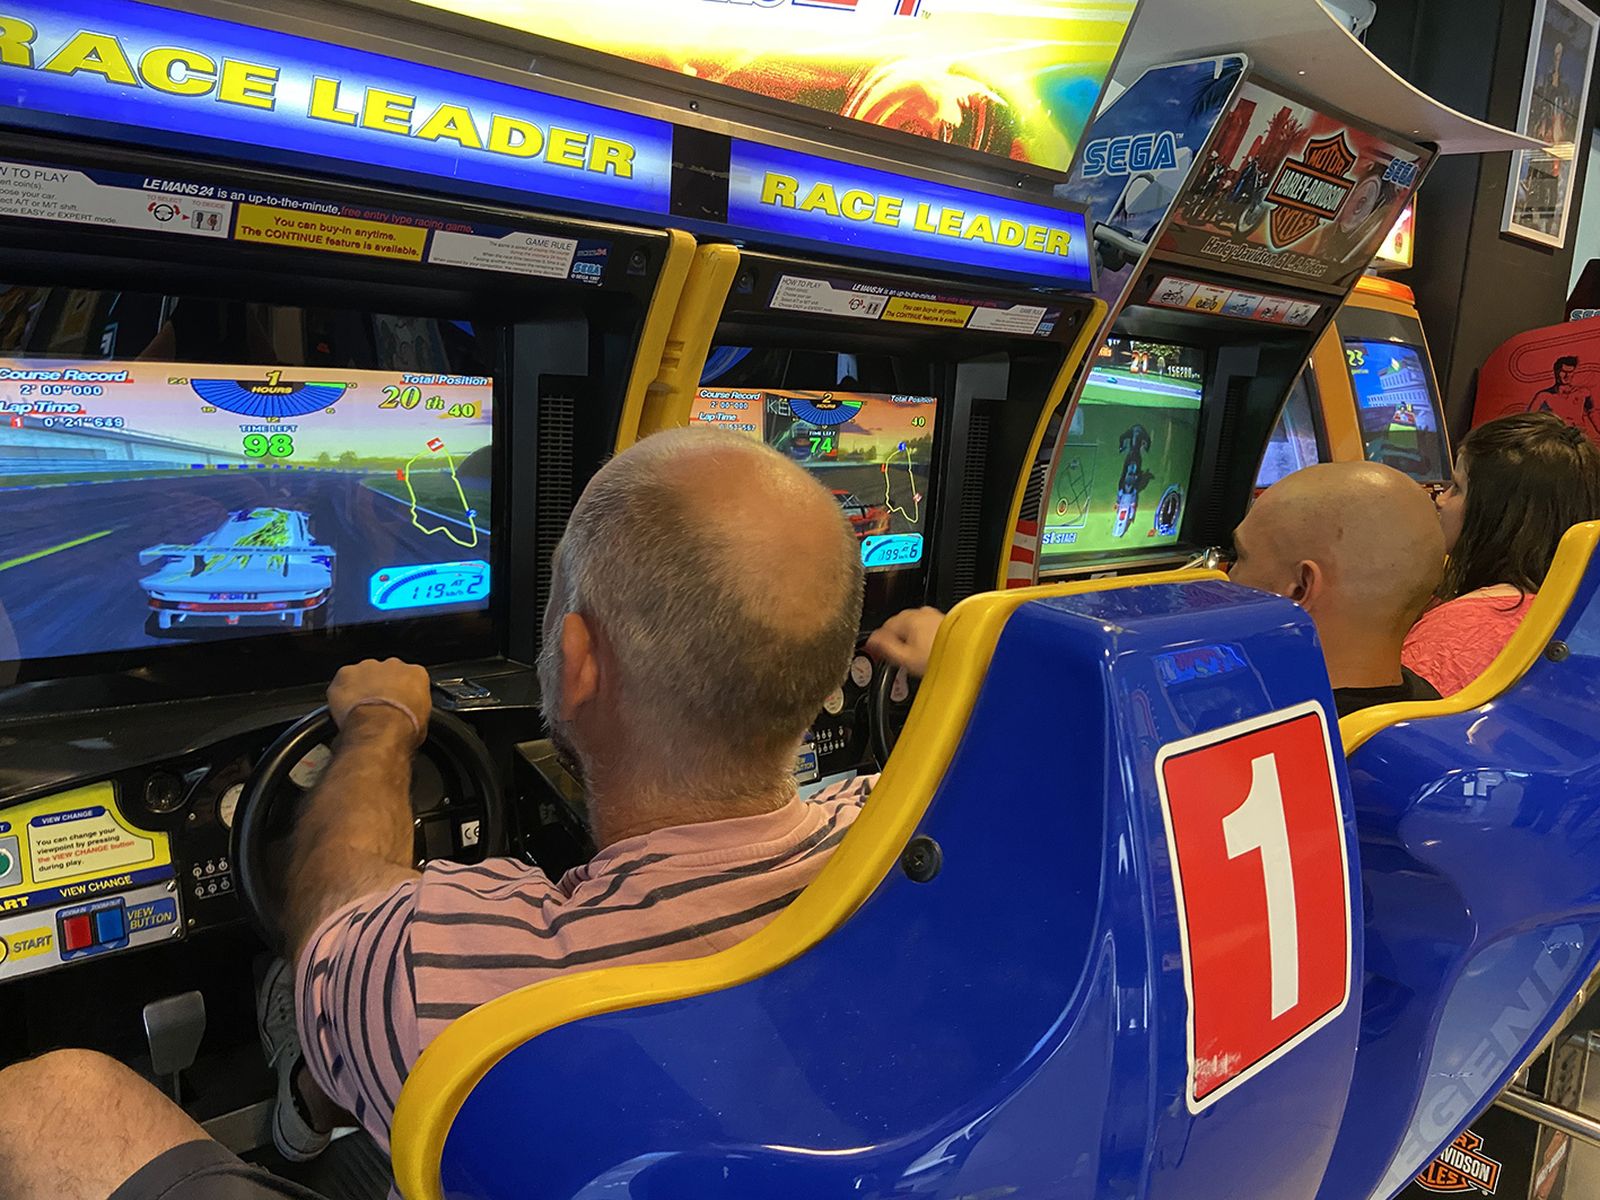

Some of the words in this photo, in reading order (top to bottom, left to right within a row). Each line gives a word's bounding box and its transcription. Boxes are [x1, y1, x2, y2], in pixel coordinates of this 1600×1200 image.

[0, 15, 281, 111] RACE
[307, 75, 636, 179] LEADER
[1081, 130, 1179, 179] SEGA
[1307, 145, 1344, 176] MOTOR
[12, 167, 31, 180] TO
[34, 170, 68, 183] PLAY
[1382, 157, 1420, 189] SEGA
[22, 190, 40, 199] your
[142, 176, 161, 190] LE
[161, 181, 199, 195] MANS
[198, 186, 215, 197] 24
[217, 188, 228, 199] is
[230, 192, 246, 202] an
[1273, 167, 1349, 214] HARLEY-DAVIDSON
[20, 207, 45, 216] EASY
[58, 211, 93, 221] EXPERT
[760, 171, 905, 228] RACE
[913, 202, 1073, 257] LEADER
[273, 216, 295, 228] You
[298, 221, 317, 230] can
[320, 222, 352, 236] buy-in
[240, 225, 262, 237] The
[264, 229, 324, 244] CONTINUE
[325, 236, 361, 249] feature
[363, 241, 372, 251] is
[525, 237, 550, 249] GAME
[551, 240, 573, 251] RULE
[1130, 349, 1150, 374] 21
[1346, 349, 1365, 367] 23
[0, 368, 62, 381] Course
[64, 369, 129, 382] Record
[265, 370, 282, 386] 1
[402, 373, 435, 385] Total
[437, 374, 489, 386] Position
[251, 386, 293, 395] HOURS
[699, 389, 731, 399] Course
[730, 391, 762, 400] Record
[822, 392, 834, 404] 2
[0, 401, 33, 415] Lap
[34, 401, 82, 414] Time
[378, 385, 422, 410] 20
[425, 395, 445, 410] th
[448, 403, 476, 418] 40
[907, 396, 935, 404] Position
[699, 412, 715, 422] Lap
[715, 412, 737, 421] Time
[911, 416, 926, 428] 40
[239, 424, 270, 433] TIME
[269, 425, 298, 433] LEFT
[243, 433, 294, 459] 98
[809, 437, 833, 454] 74
[909, 543, 919, 559] 6
[412, 583, 446, 600] 119
[466, 574, 484, 595] 2
[450, 579, 465, 587] AT
[41, 815, 61, 825] VIEW
[61, 809, 93, 821] CHANGE
[36, 839, 52, 847] You
[53, 836, 68, 844] can
[69, 830, 98, 842] change
[99, 827, 116, 837] your
[36, 843, 75, 856] viewpoint
[75, 841, 86, 849] by
[87, 835, 121, 847] pressing
[37, 856, 51, 864] the
[52, 851, 73, 862] VIEW
[74, 844, 109, 858] CHANGE
[110, 839, 135, 850] button
[38, 861, 65, 873] during
[60, 884, 87, 898] VIEW
[88, 875, 134, 892] CHANGE
[1221, 753, 1299, 1022] 1
[127, 906, 155, 921] VIEW
[130, 911, 172, 930] BUTTON
[14, 935, 53, 953] START
